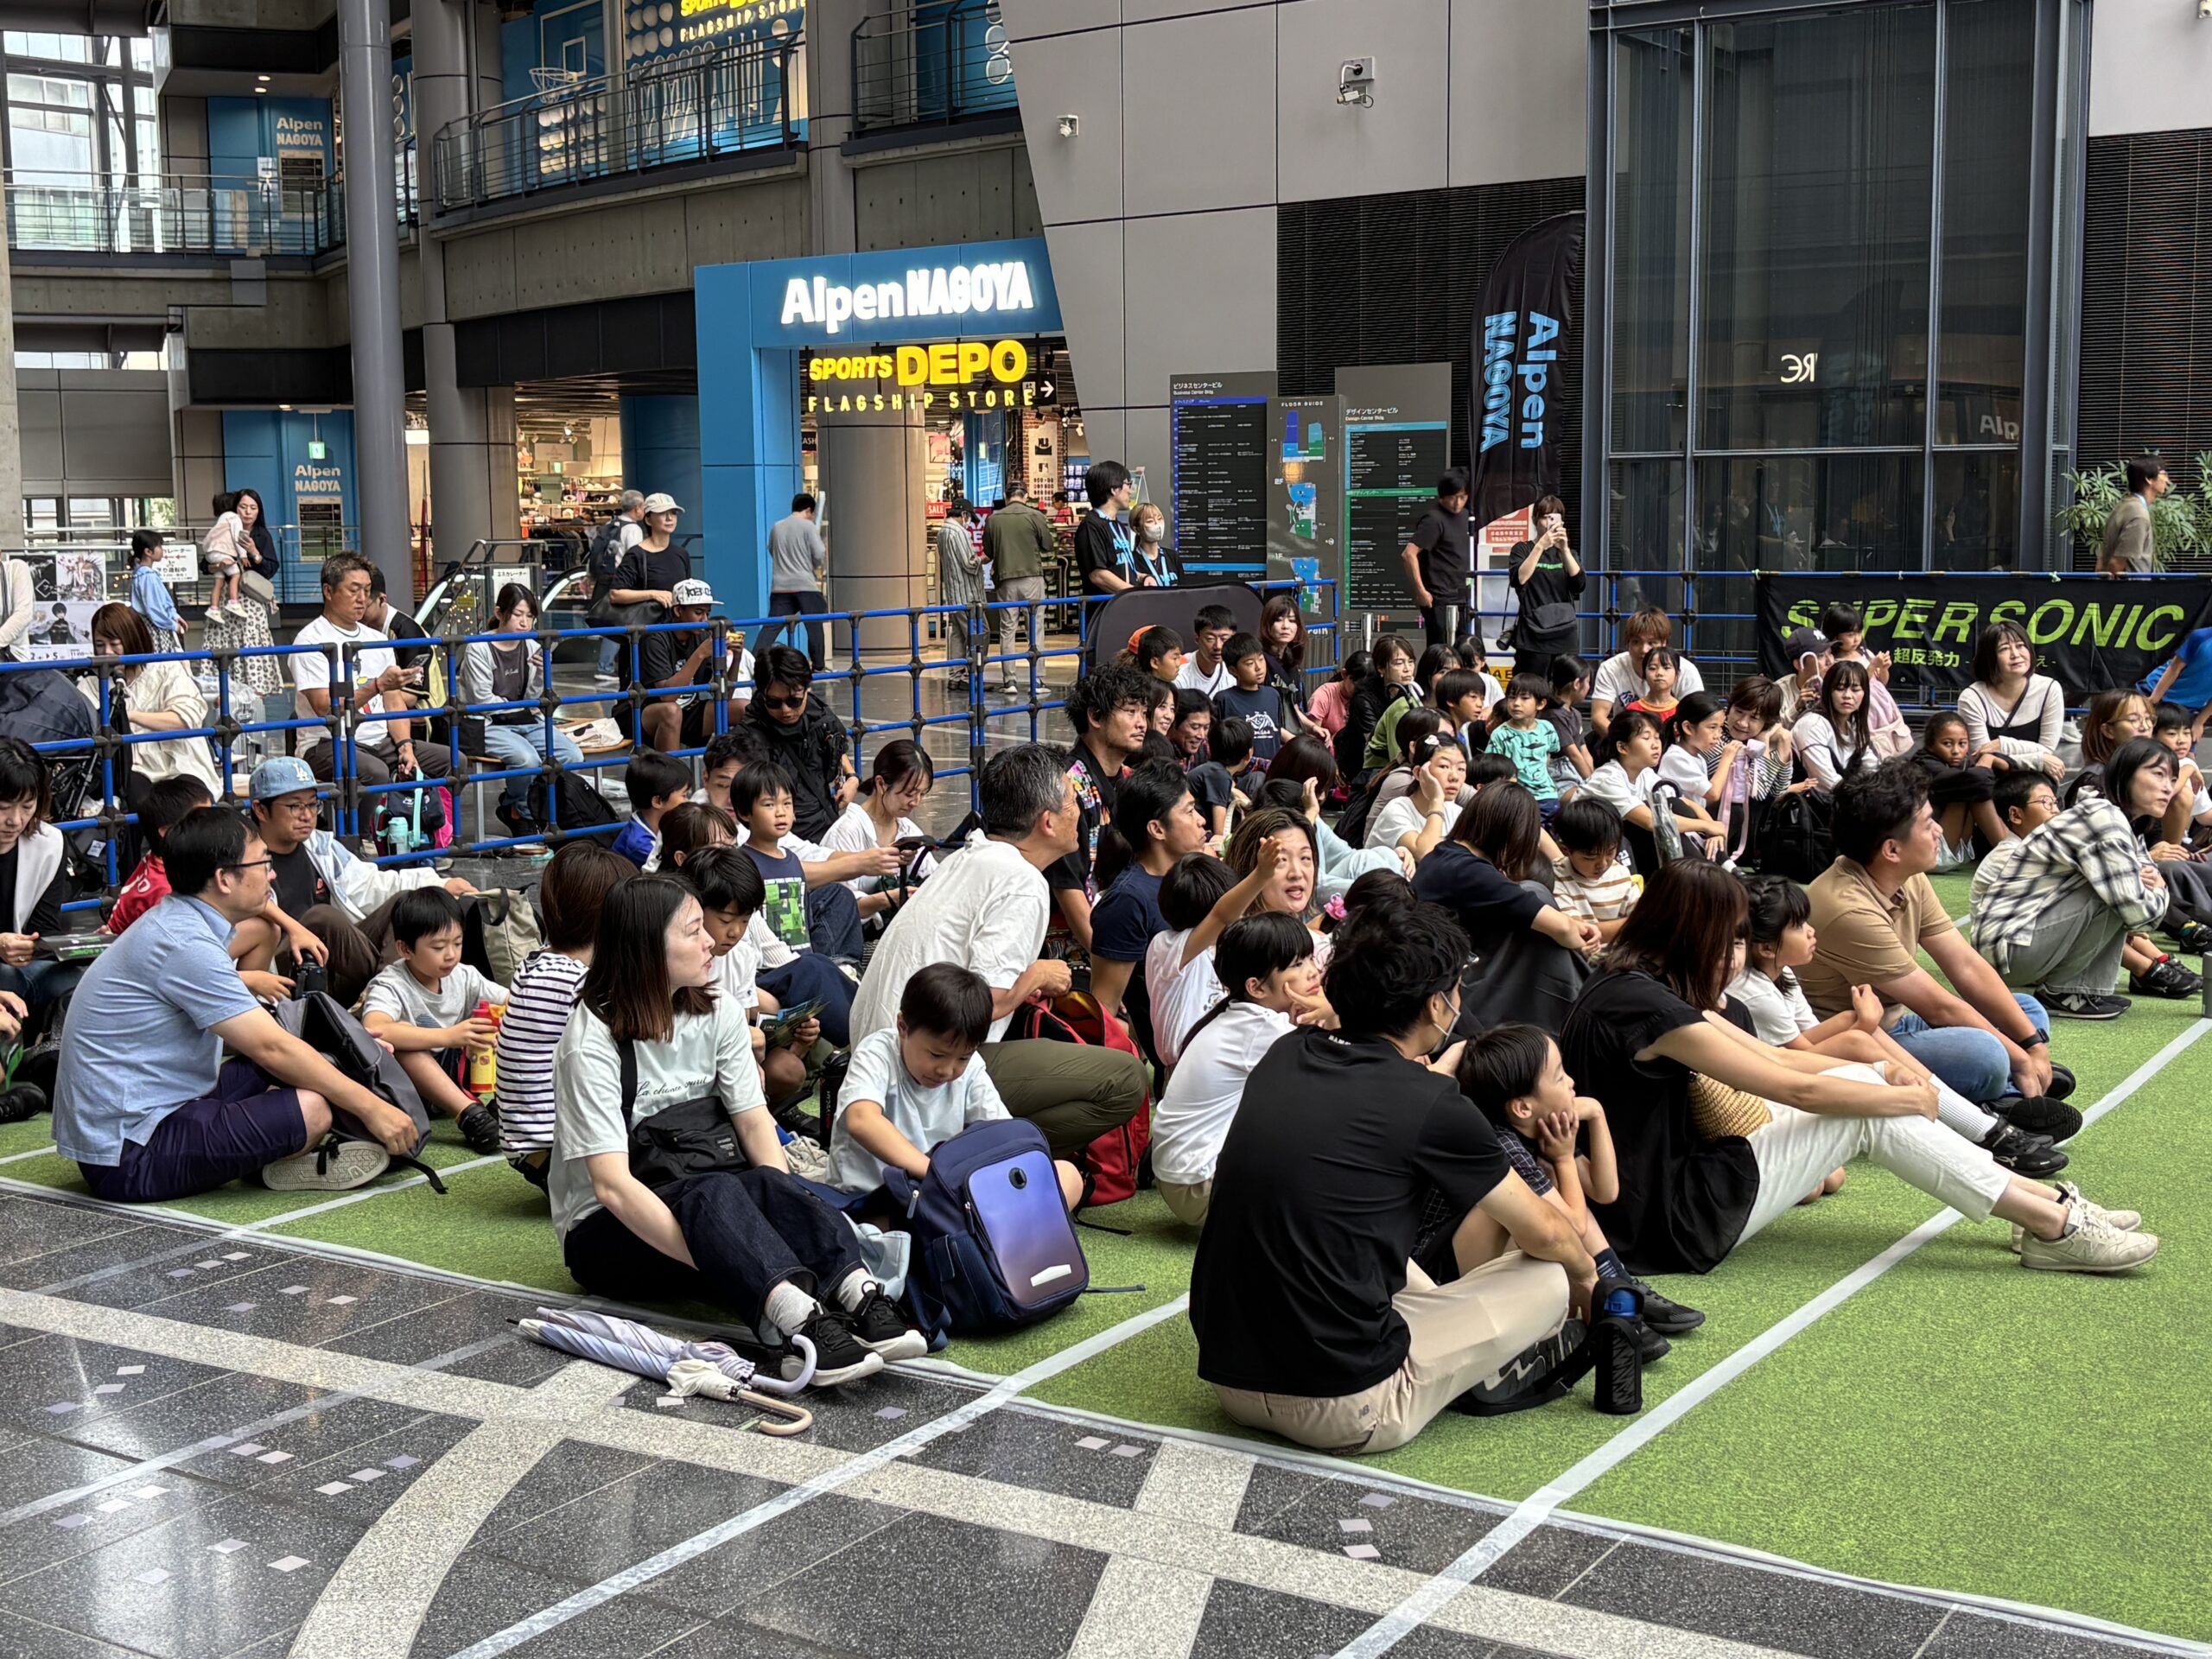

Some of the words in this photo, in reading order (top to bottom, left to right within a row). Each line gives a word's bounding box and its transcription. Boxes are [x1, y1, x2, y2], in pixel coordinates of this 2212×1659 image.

[680, 0, 728, 16] SPO
[680, 10, 752, 42] FLAGSHIP
[276, 117, 323, 132] Alpen
[276, 133, 323, 146] NAGOYA
[780, 276, 905, 334] Alpen
[906, 261, 1034, 316] NAGOYA
[810, 355, 893, 381] SPORTS
[896, 340, 1027, 386] DEPO
[1480, 311, 1516, 453] NAGOYA
[1517, 311, 1559, 448] Alpen
[808, 394, 933, 413] FLAGSHIP
[950, 389, 1033, 409] STORE
[295, 464, 340, 479] Alpen
[295, 480, 340, 492] NAGOYA
[928, 505, 944, 514] SALE
[1781, 599, 1979, 643] SPER
[1988, 599, 2184, 651] SONIC
[1893, 647, 1961, 668] 超反発力
[1493, 670, 1513, 679] AE
